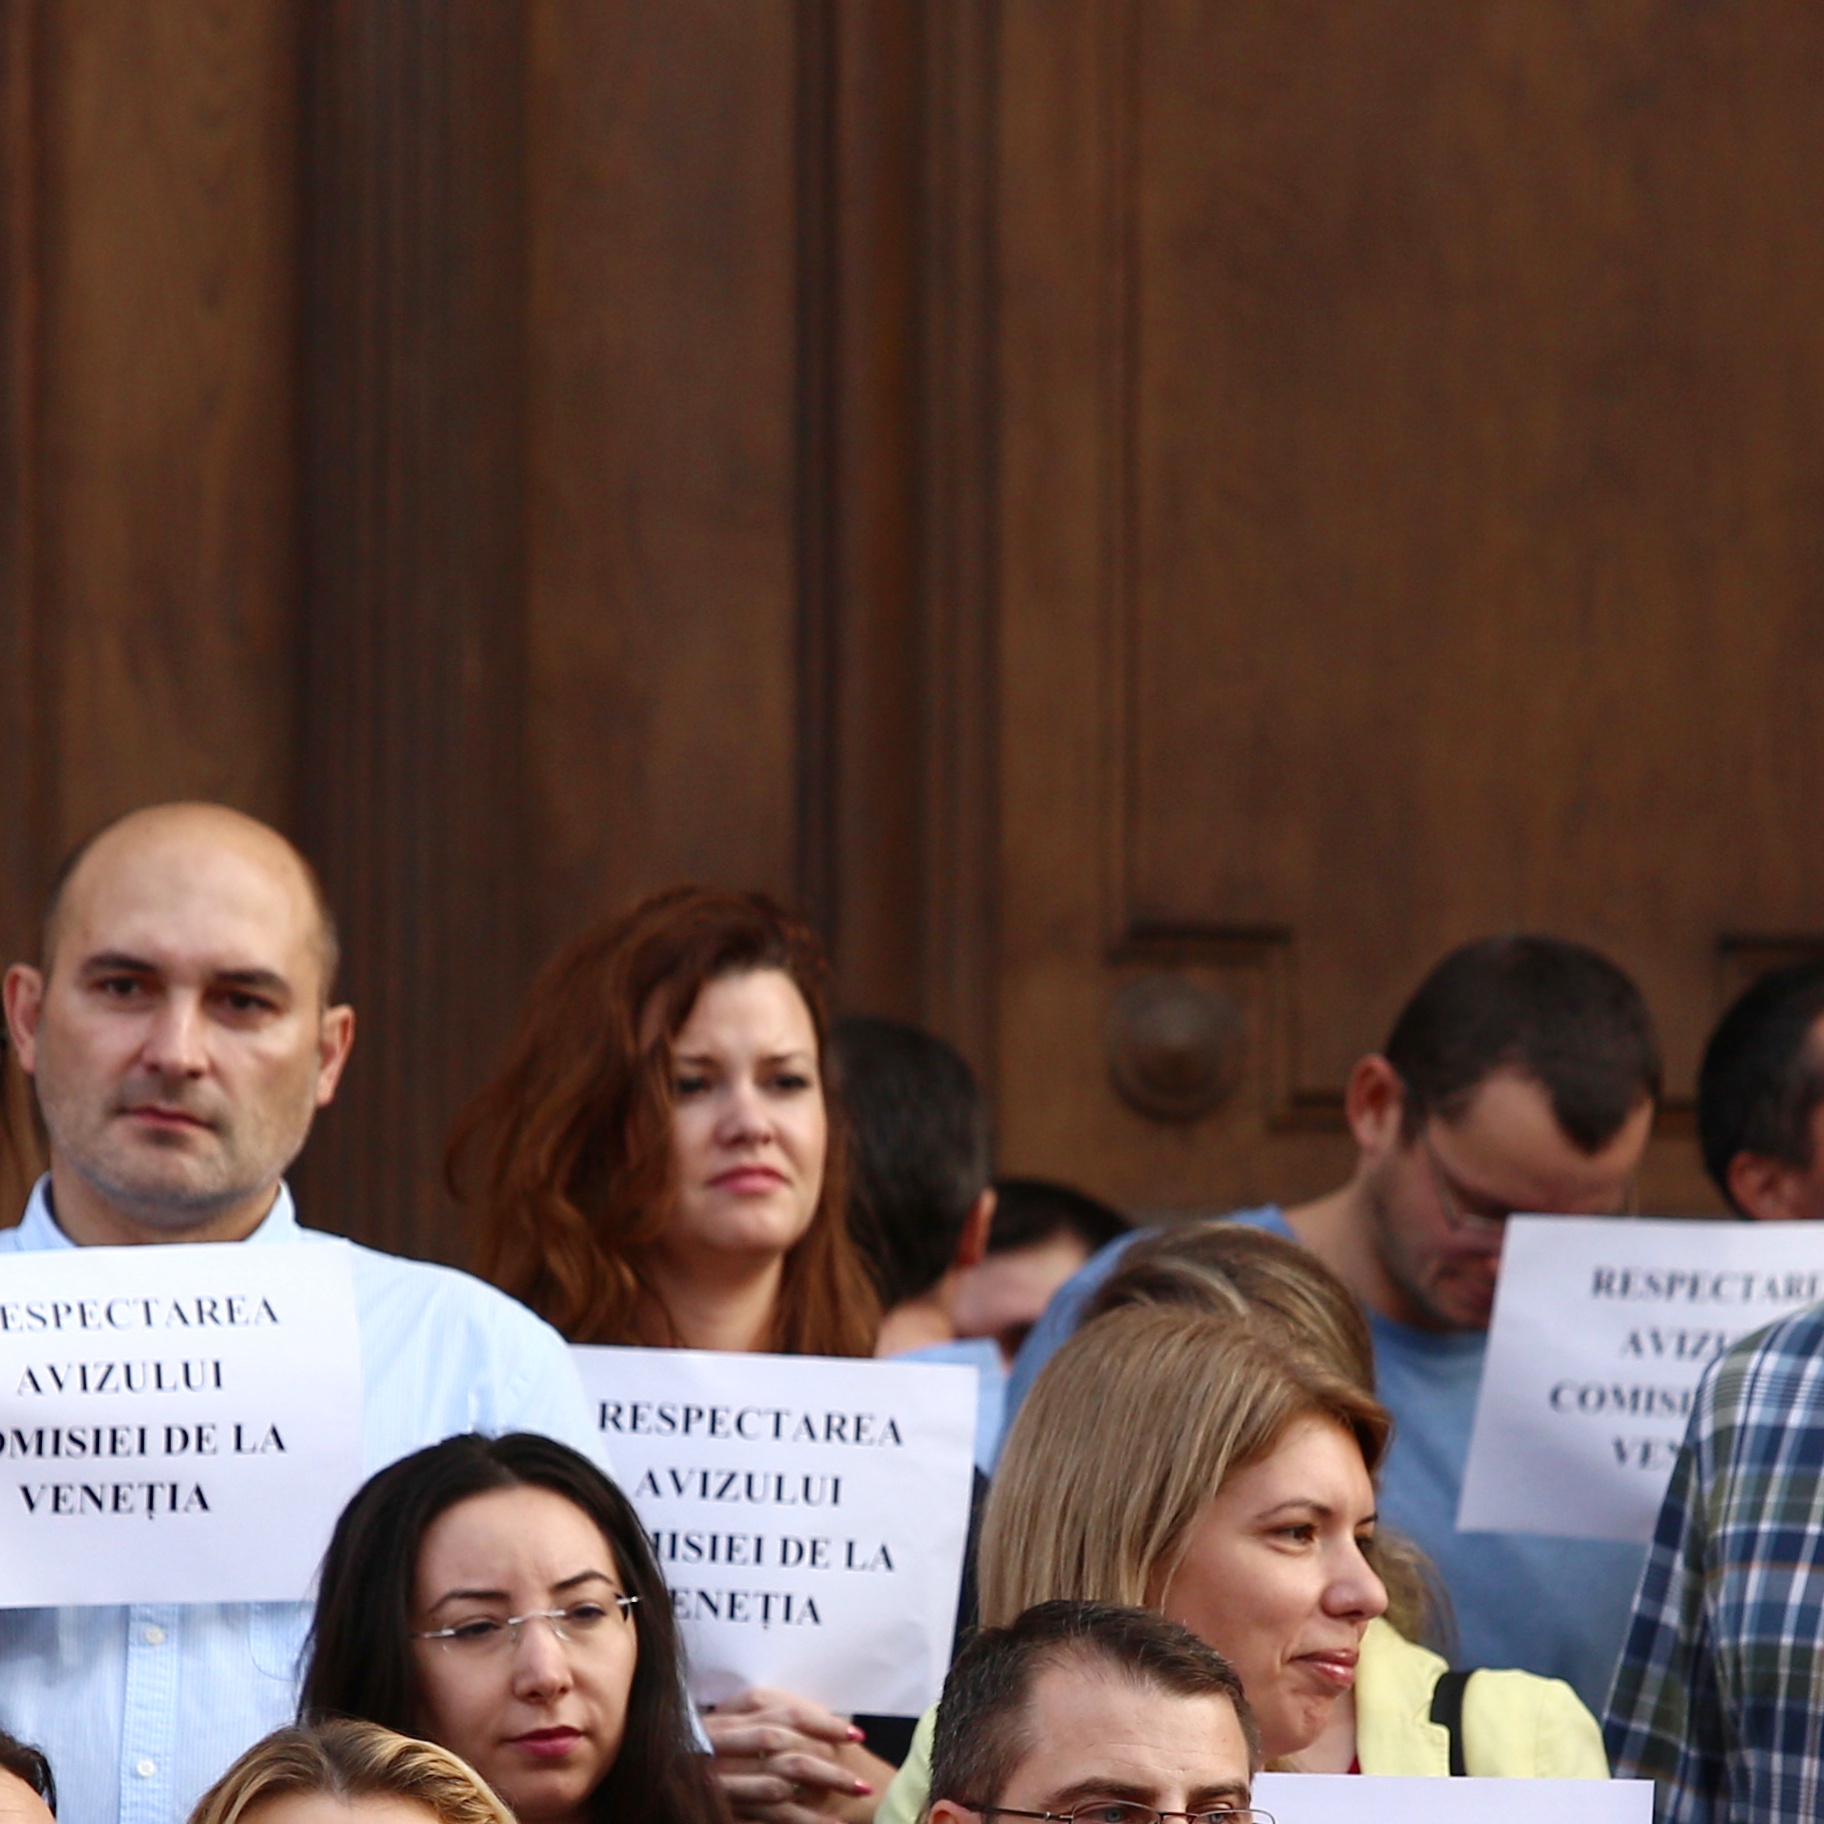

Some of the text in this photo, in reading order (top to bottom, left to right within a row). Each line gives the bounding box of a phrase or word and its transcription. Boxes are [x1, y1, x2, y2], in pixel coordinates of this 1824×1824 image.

[16, 1359, 224, 1396] AVIZULUI
[163, 1424, 218, 1455] DE
[232, 1422, 287, 1454] LA
[598, 1400, 905, 1447] RESPECTAREA
[18, 1482, 211, 1520] VENEȚIA
[634, 1468, 843, 1508] AVIZULUI
[779, 1538, 831, 1570] DE
[844, 1541, 896, 1572] LA
